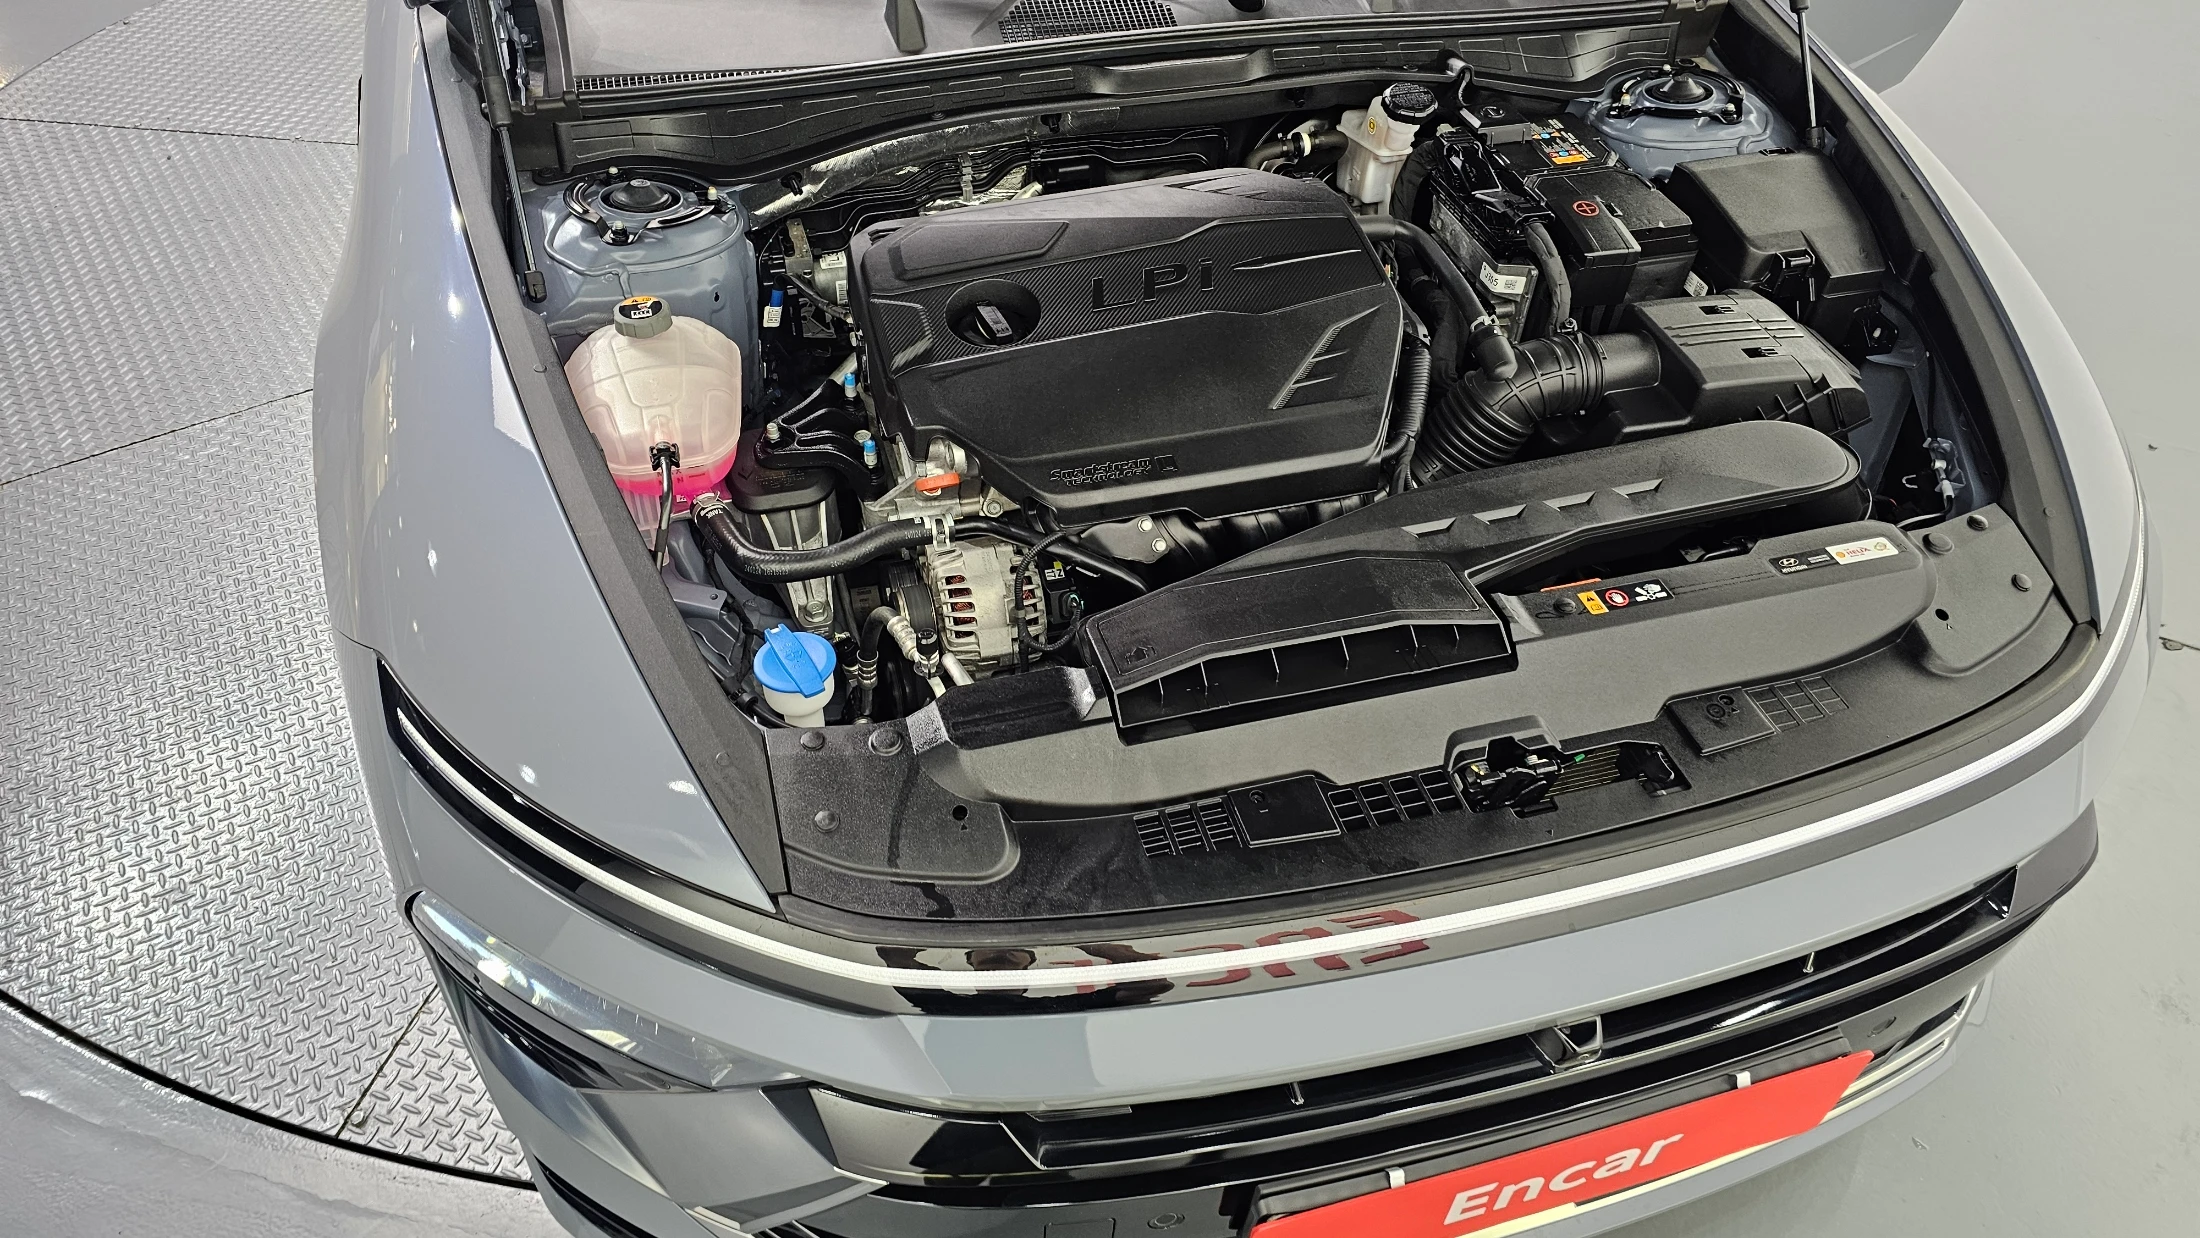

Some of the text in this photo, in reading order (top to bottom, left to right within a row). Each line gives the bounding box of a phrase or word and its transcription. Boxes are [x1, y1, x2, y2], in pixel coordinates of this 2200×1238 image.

[1092, 256, 1214, 312] LPi
[1050, 457, 1152, 481] Smartstream
[1443, 1133, 1685, 1226] Encar
